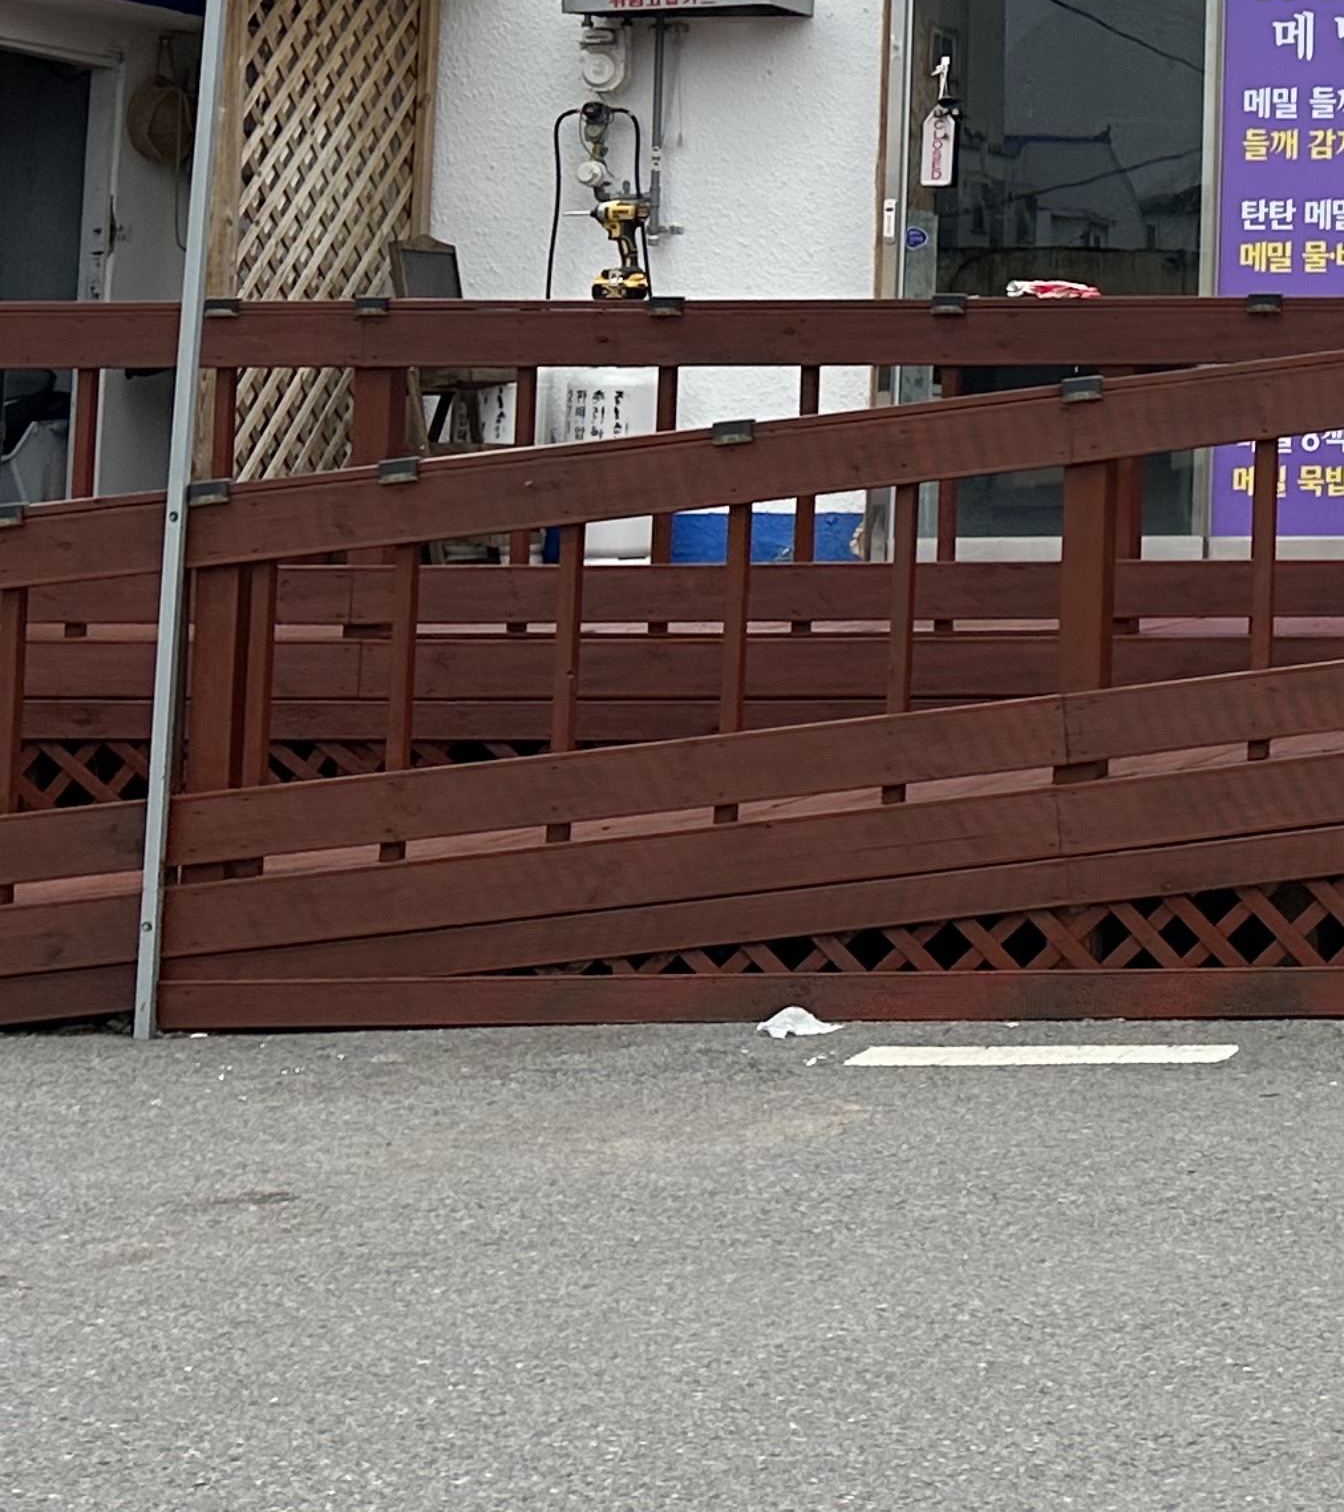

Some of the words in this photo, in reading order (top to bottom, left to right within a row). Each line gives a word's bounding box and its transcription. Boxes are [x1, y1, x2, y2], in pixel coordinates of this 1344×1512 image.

[1242, 87, 1298, 119] 메밀
[1242, 128, 1299, 160] 들깨
[1241, 198, 1296, 230] 탄탄
[1239, 241, 1292, 273] 메밀
